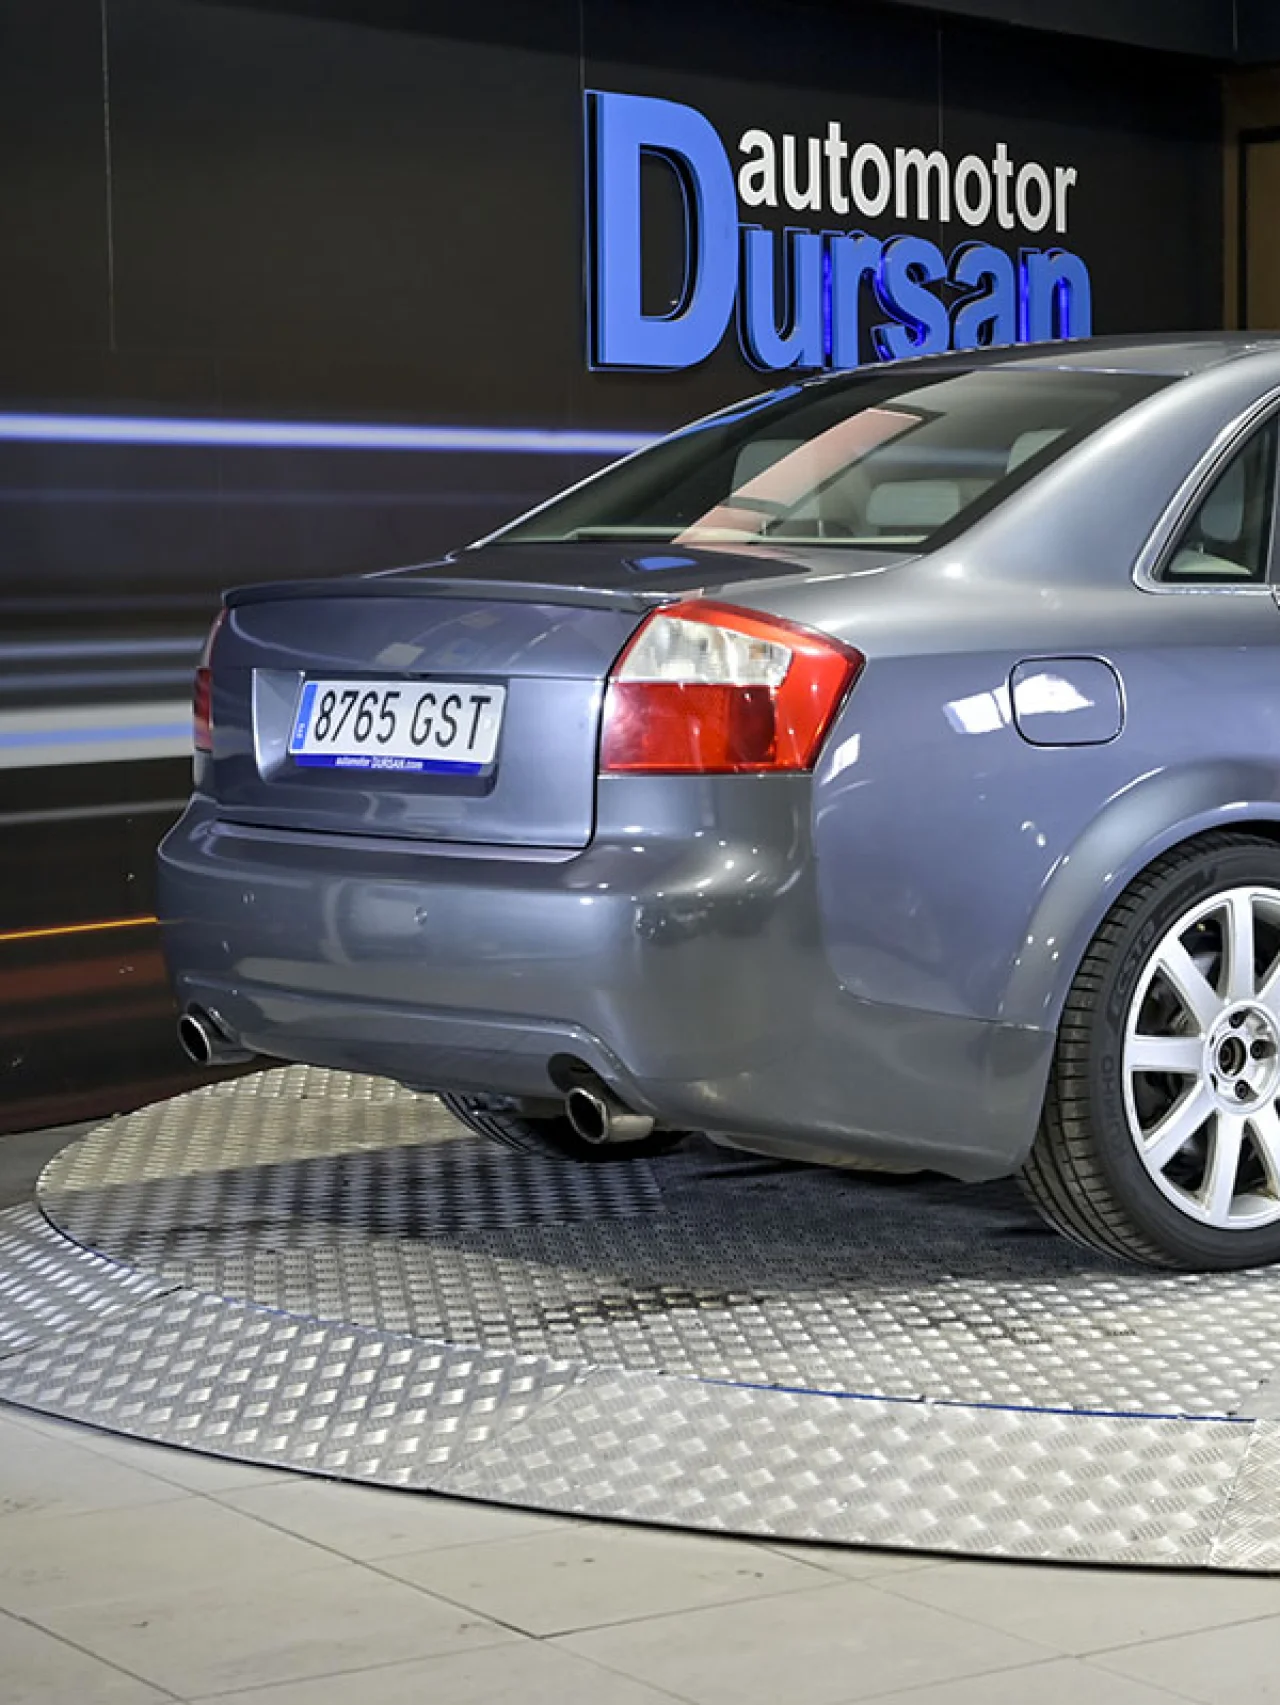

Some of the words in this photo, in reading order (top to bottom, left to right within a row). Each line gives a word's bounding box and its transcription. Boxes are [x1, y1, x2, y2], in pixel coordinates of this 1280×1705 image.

[584, 89, 1092, 371] Dursan
[737, 121, 1077, 233] automotor
[314, 690, 400, 743] 8765
[410, 692, 492, 750] GST
